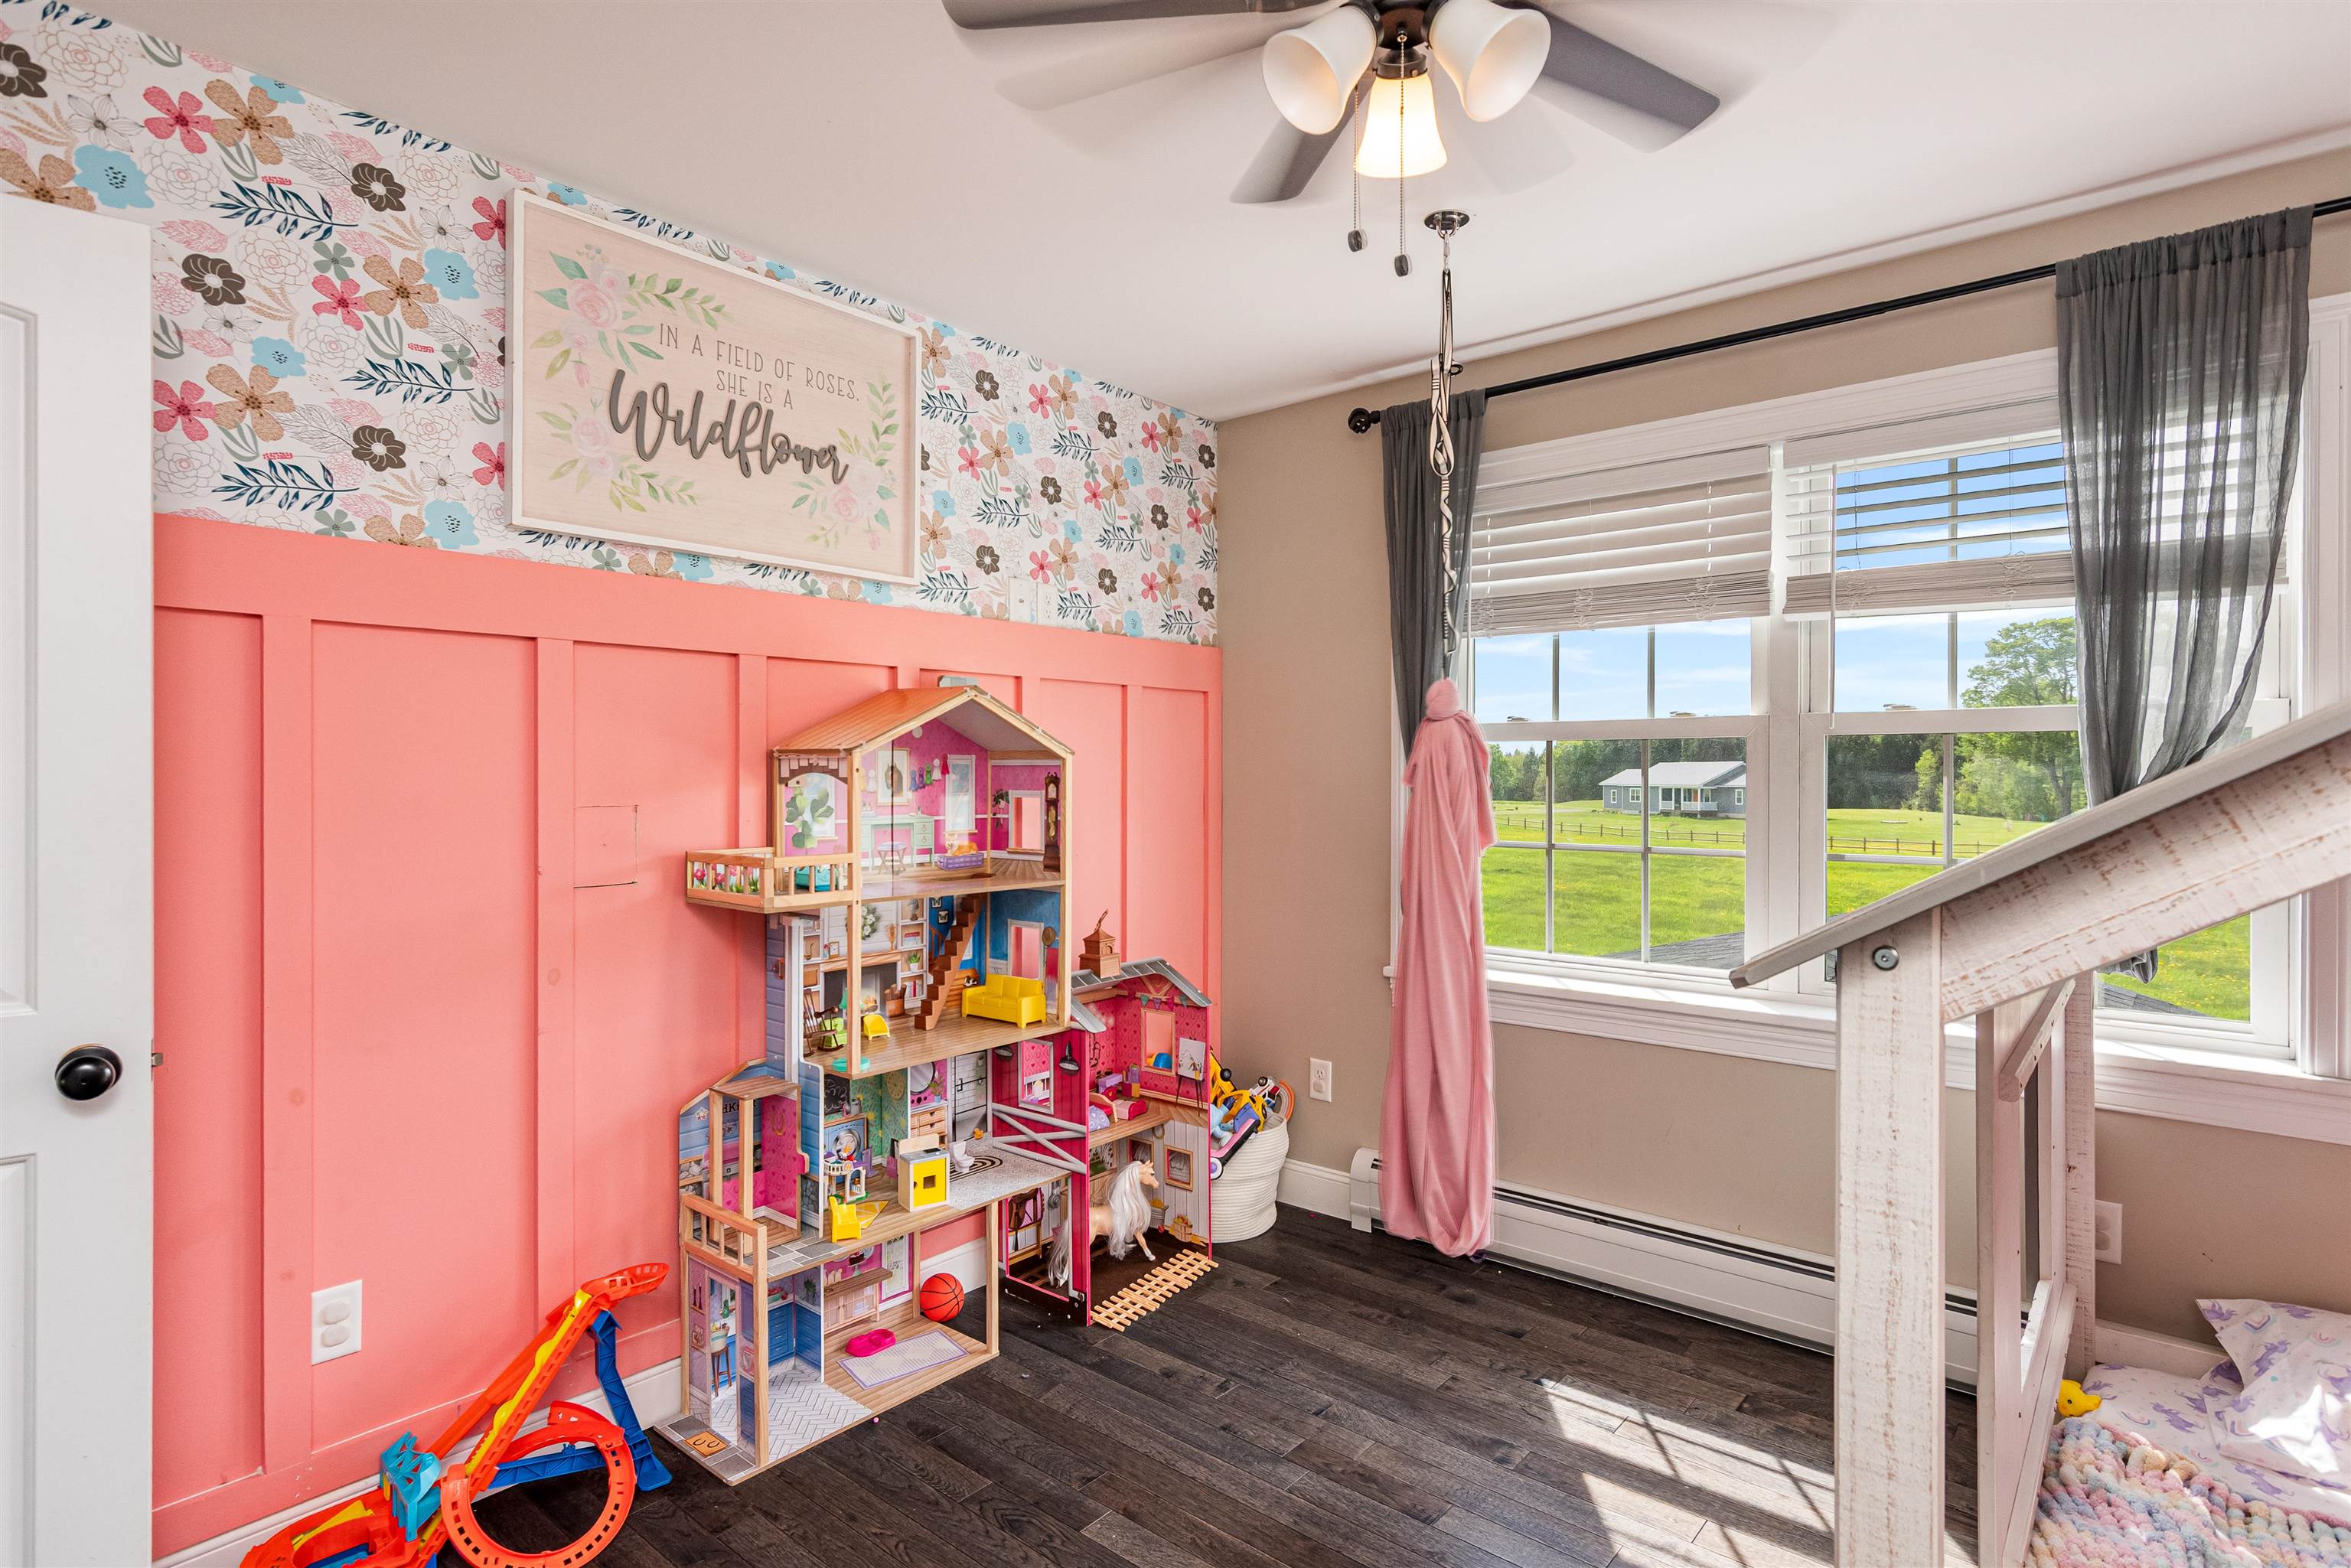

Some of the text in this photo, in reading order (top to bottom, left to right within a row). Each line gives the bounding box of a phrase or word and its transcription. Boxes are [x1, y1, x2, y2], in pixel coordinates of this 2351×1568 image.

[659, 323, 679, 349] IN
[691, 334, 703, 357] A
[716, 340, 764, 373] FIELD
[774, 358, 795, 381] OF
[716, 370, 794, 410] SHE IS A
[608, 369, 849, 484] Wildflower
